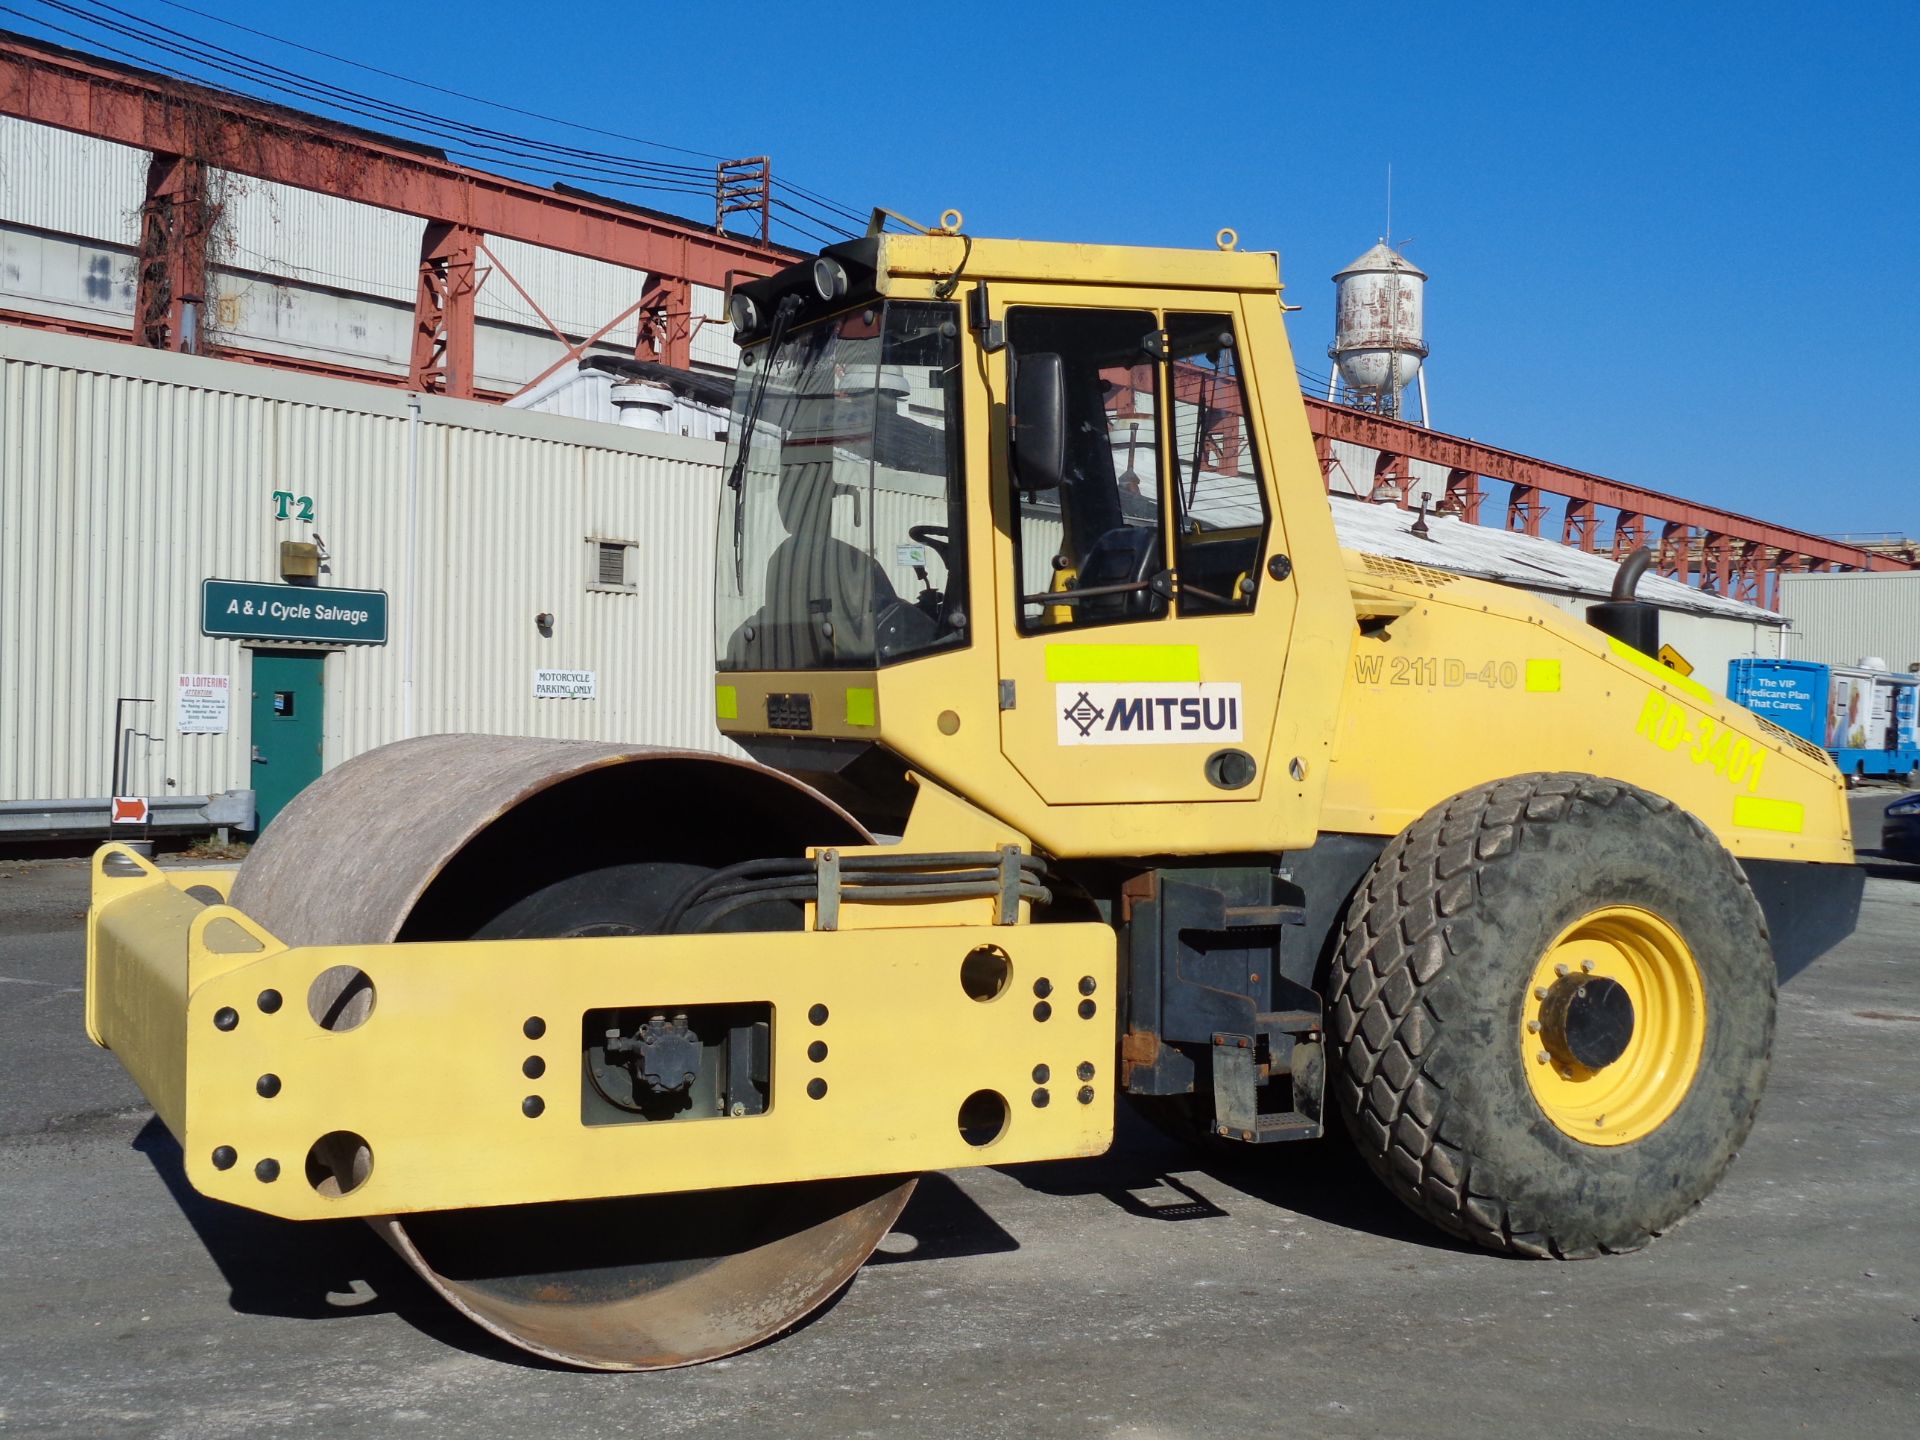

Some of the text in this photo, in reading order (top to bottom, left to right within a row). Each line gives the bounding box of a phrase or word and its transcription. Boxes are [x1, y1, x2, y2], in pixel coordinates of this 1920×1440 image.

[272, 490, 315, 523] T2
[227, 599, 369, 625] A & J Cycle Salvage
[180, 677, 228, 688] NO LOITERING
[539, 672, 590, 682] MOTORCYCLE
[1758, 678, 1796, 688] The VIP
[536, 684, 592, 694] PARKING ONLY
[1788, 690, 1810, 700] Plan
[1749, 699, 1803, 710] That Cares.
[1105, 696, 1237, 732] MITSUI
[1636, 689, 1768, 794] RD-3401
